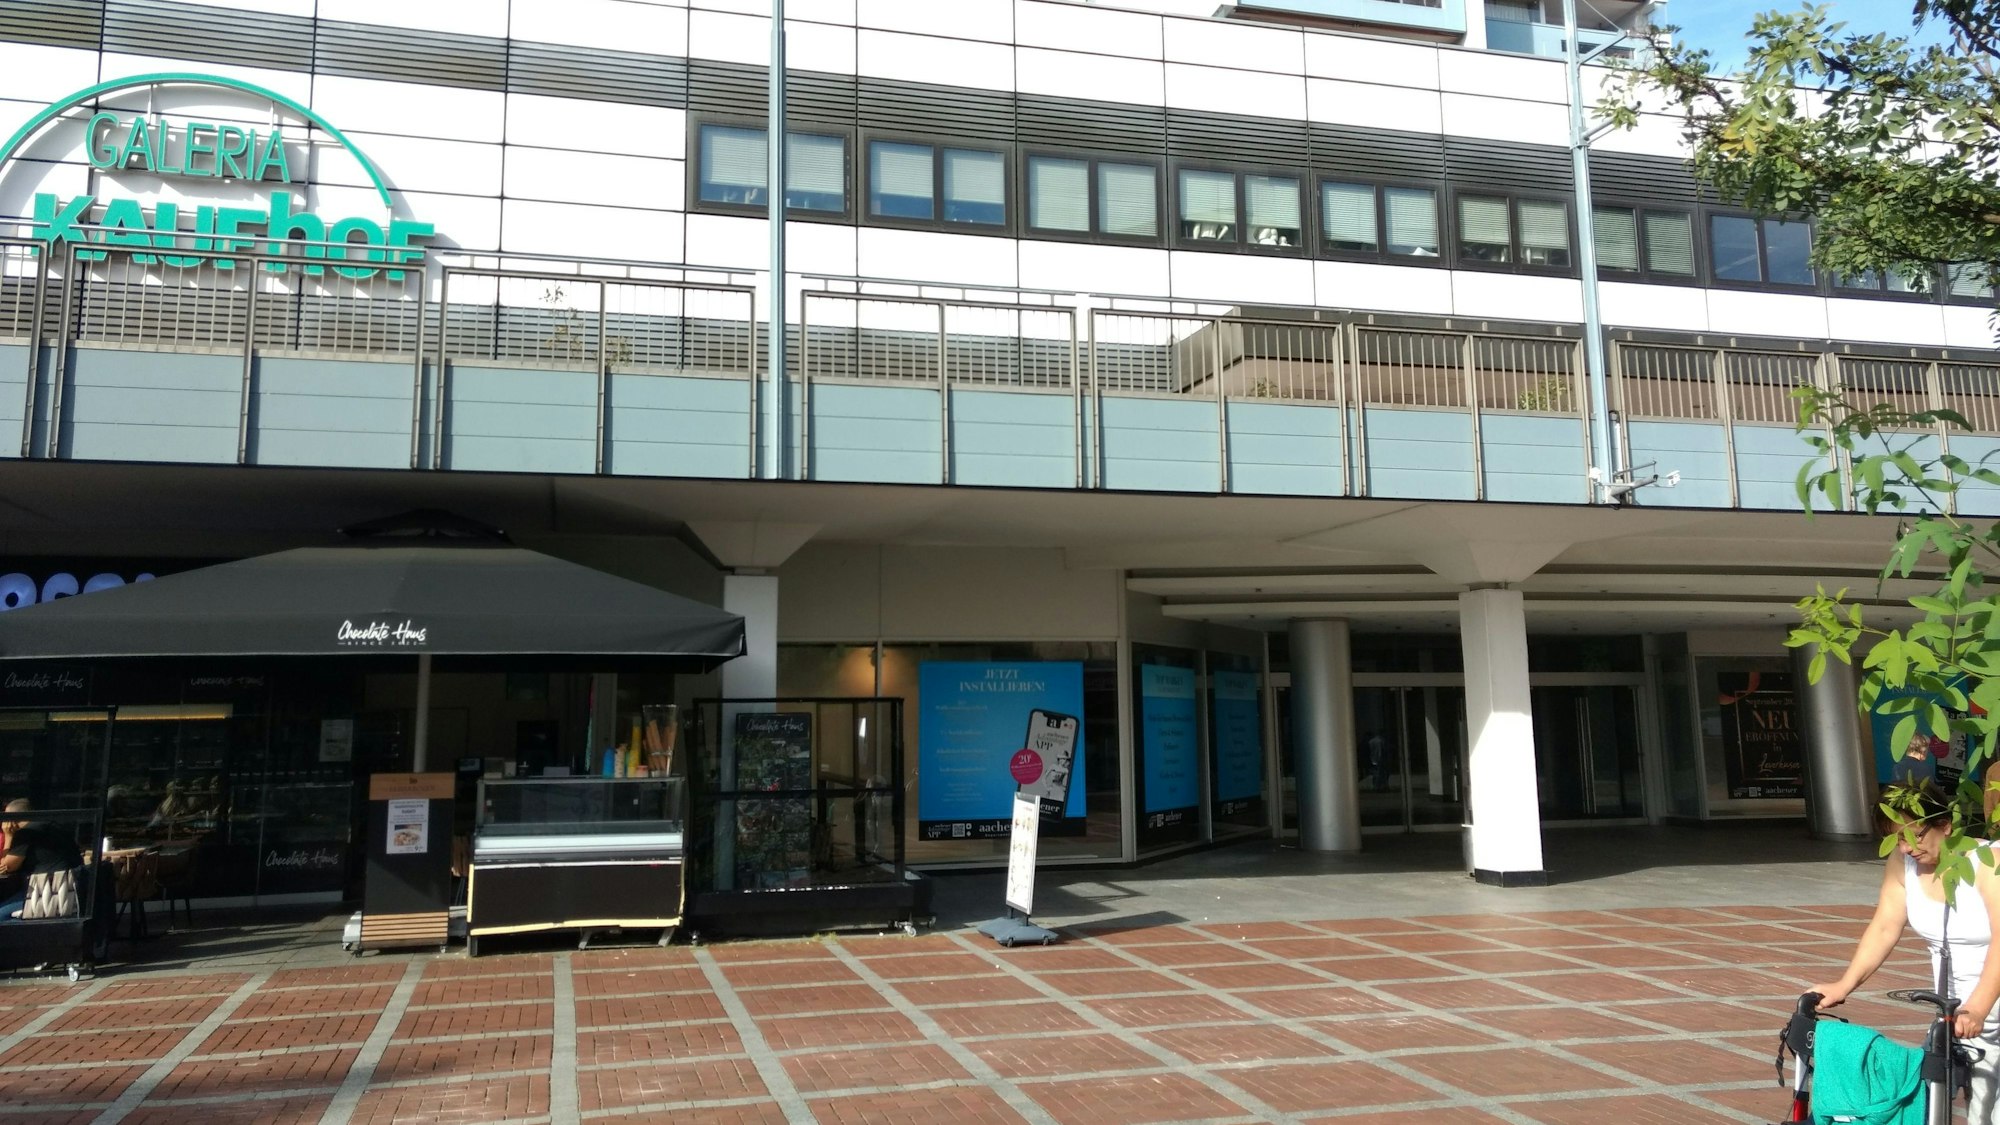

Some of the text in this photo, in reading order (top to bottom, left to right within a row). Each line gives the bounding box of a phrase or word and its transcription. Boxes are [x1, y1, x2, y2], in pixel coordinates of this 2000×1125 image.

[85, 112, 291, 183] GALERIA
[337, 619, 427, 645] Chocolate Haus
[5, 672, 84, 692] Chocolate Haus
[985, 669, 1020, 679] JETZT
[960, 681, 1045, 692] INSTALLIEREN!
[979, 820, 1013, 833] aache
[265, 848, 339, 868] Chocolate Haus
